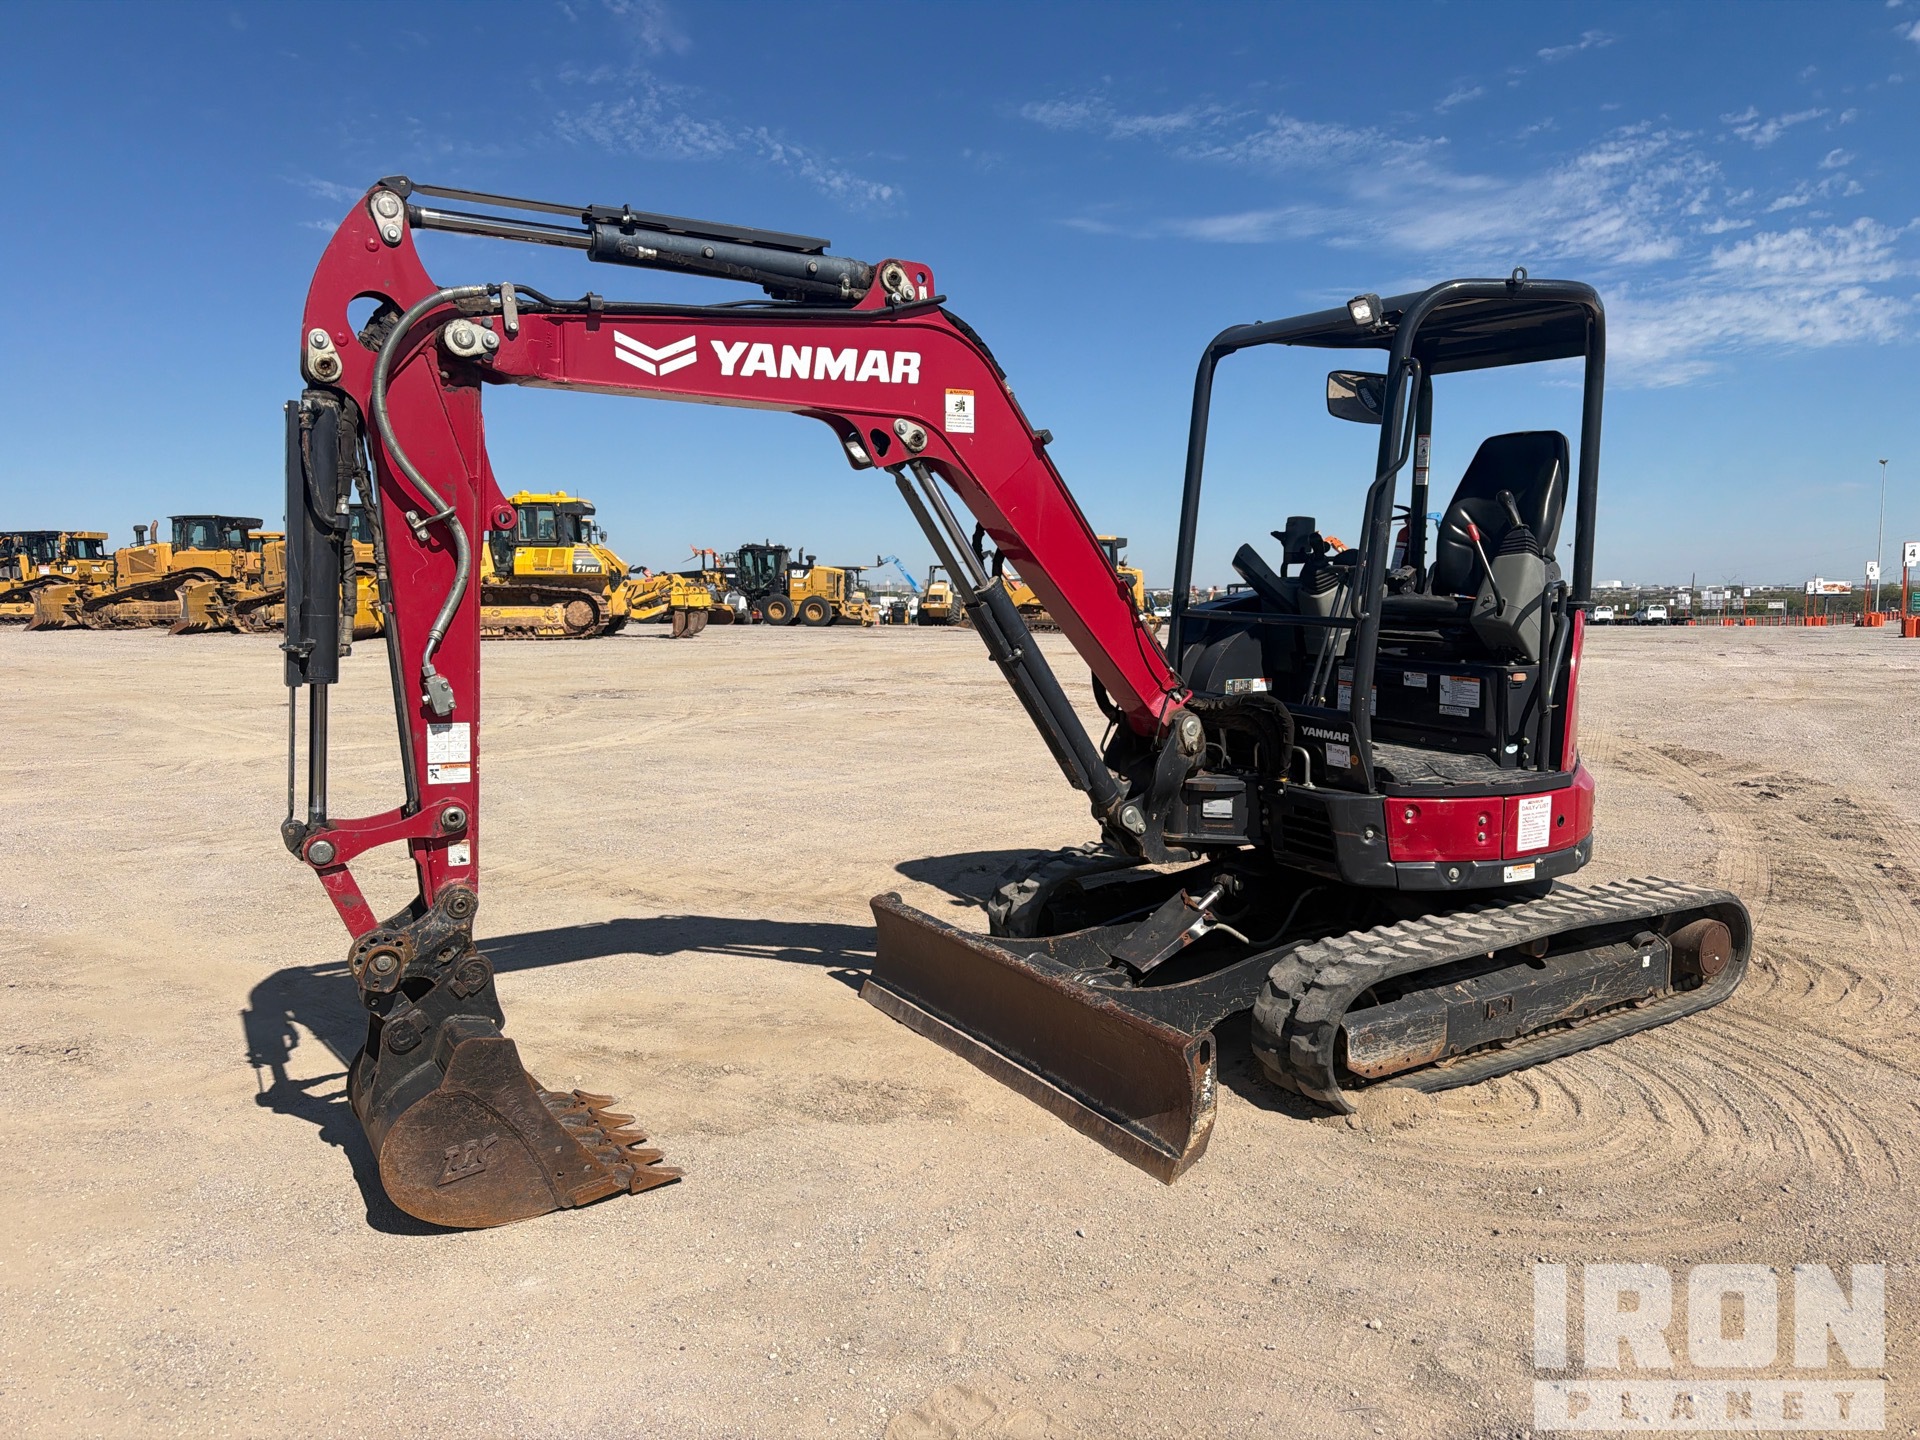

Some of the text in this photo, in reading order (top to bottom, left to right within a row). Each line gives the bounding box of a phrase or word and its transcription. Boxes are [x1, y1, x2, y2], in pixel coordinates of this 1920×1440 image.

[710, 340, 922, 385] YANMAR
[1909, 548, 1917, 558] 4
[62, 566, 73, 574] CAT
[791, 569, 805, 578] CAT
[1869, 565, 1875, 573] 6
[1301, 725, 1350, 743] YANMAR
